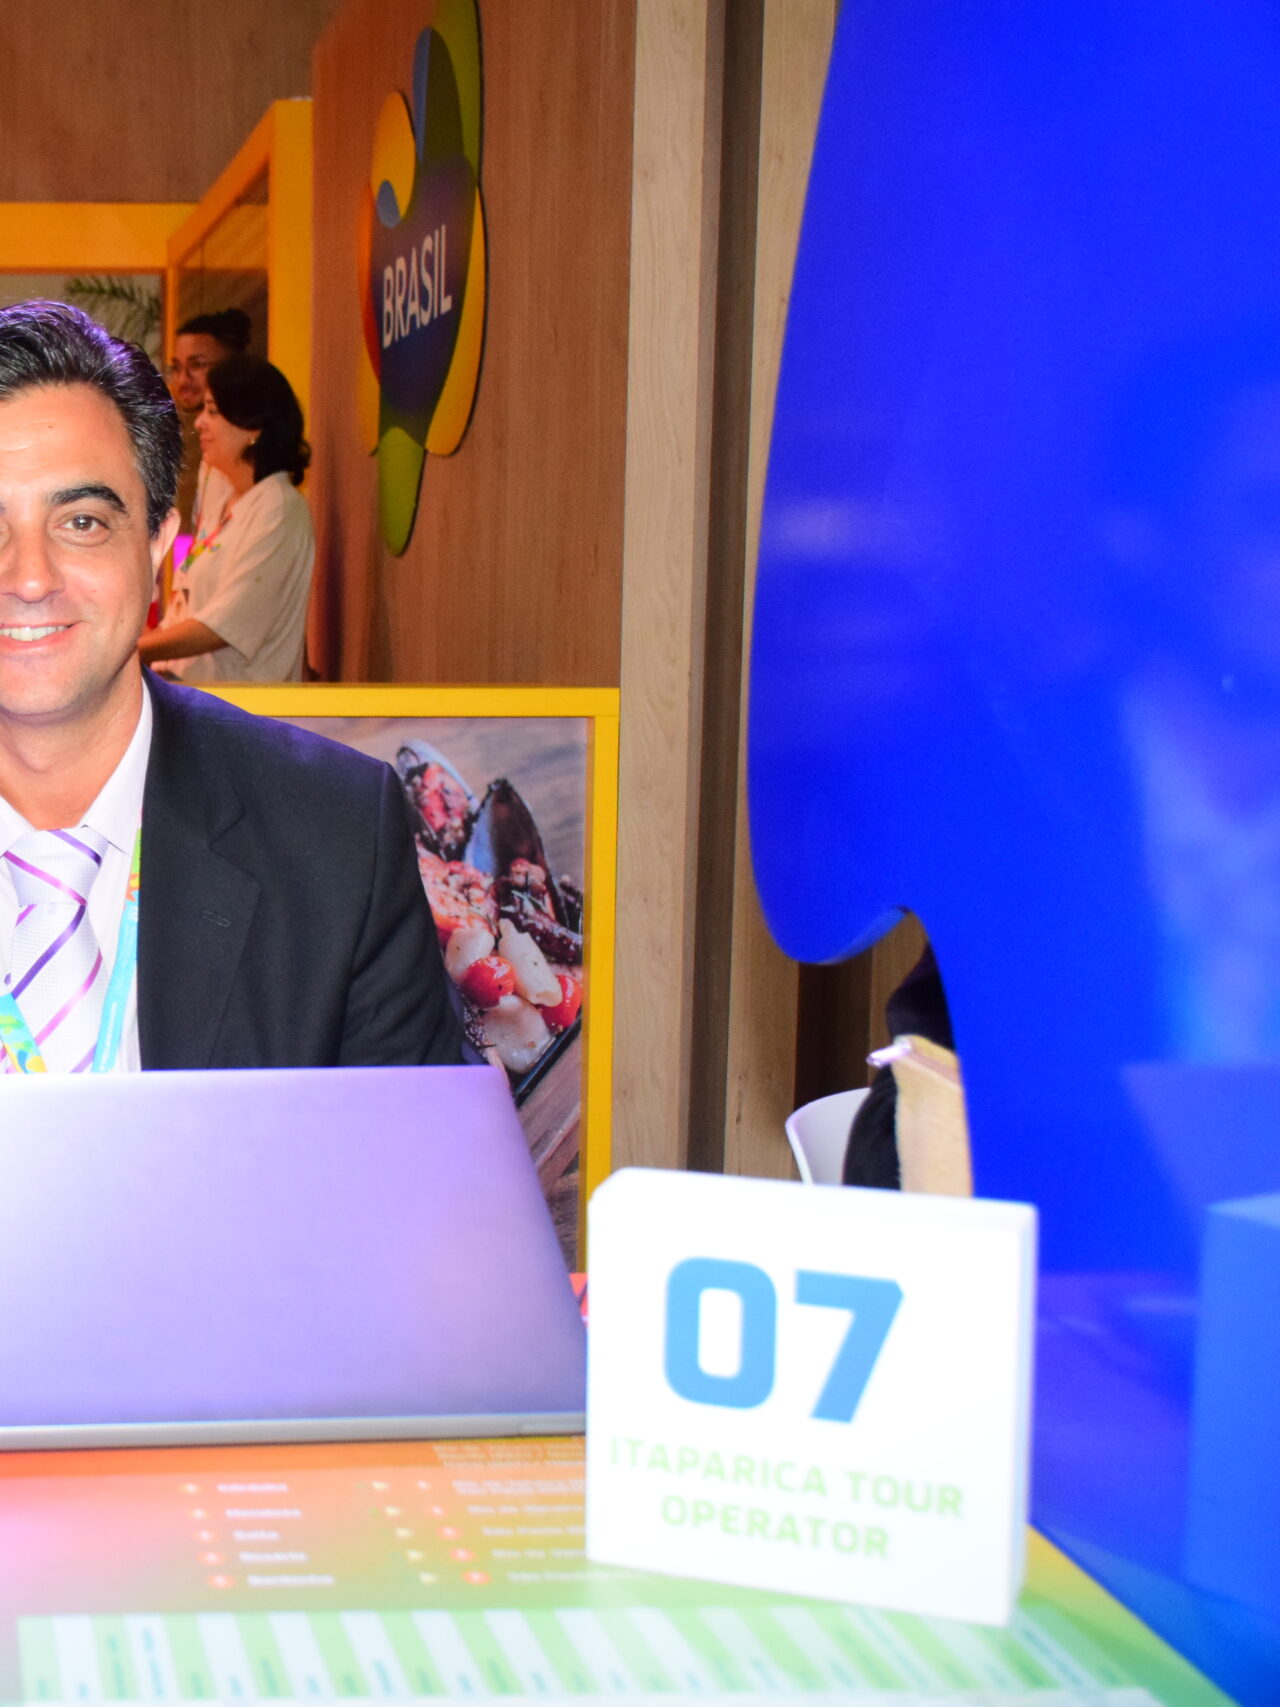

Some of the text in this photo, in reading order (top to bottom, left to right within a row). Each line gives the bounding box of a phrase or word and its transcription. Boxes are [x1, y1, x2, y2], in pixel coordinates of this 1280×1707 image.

[383, 224, 452, 349] BRASIL
[663, 1256, 905, 1424] 07
[609, 1435, 829, 1497] ITAPARICA
[845, 1468, 966, 1518] TOUR
[661, 1494, 892, 1560] OPERATOR
